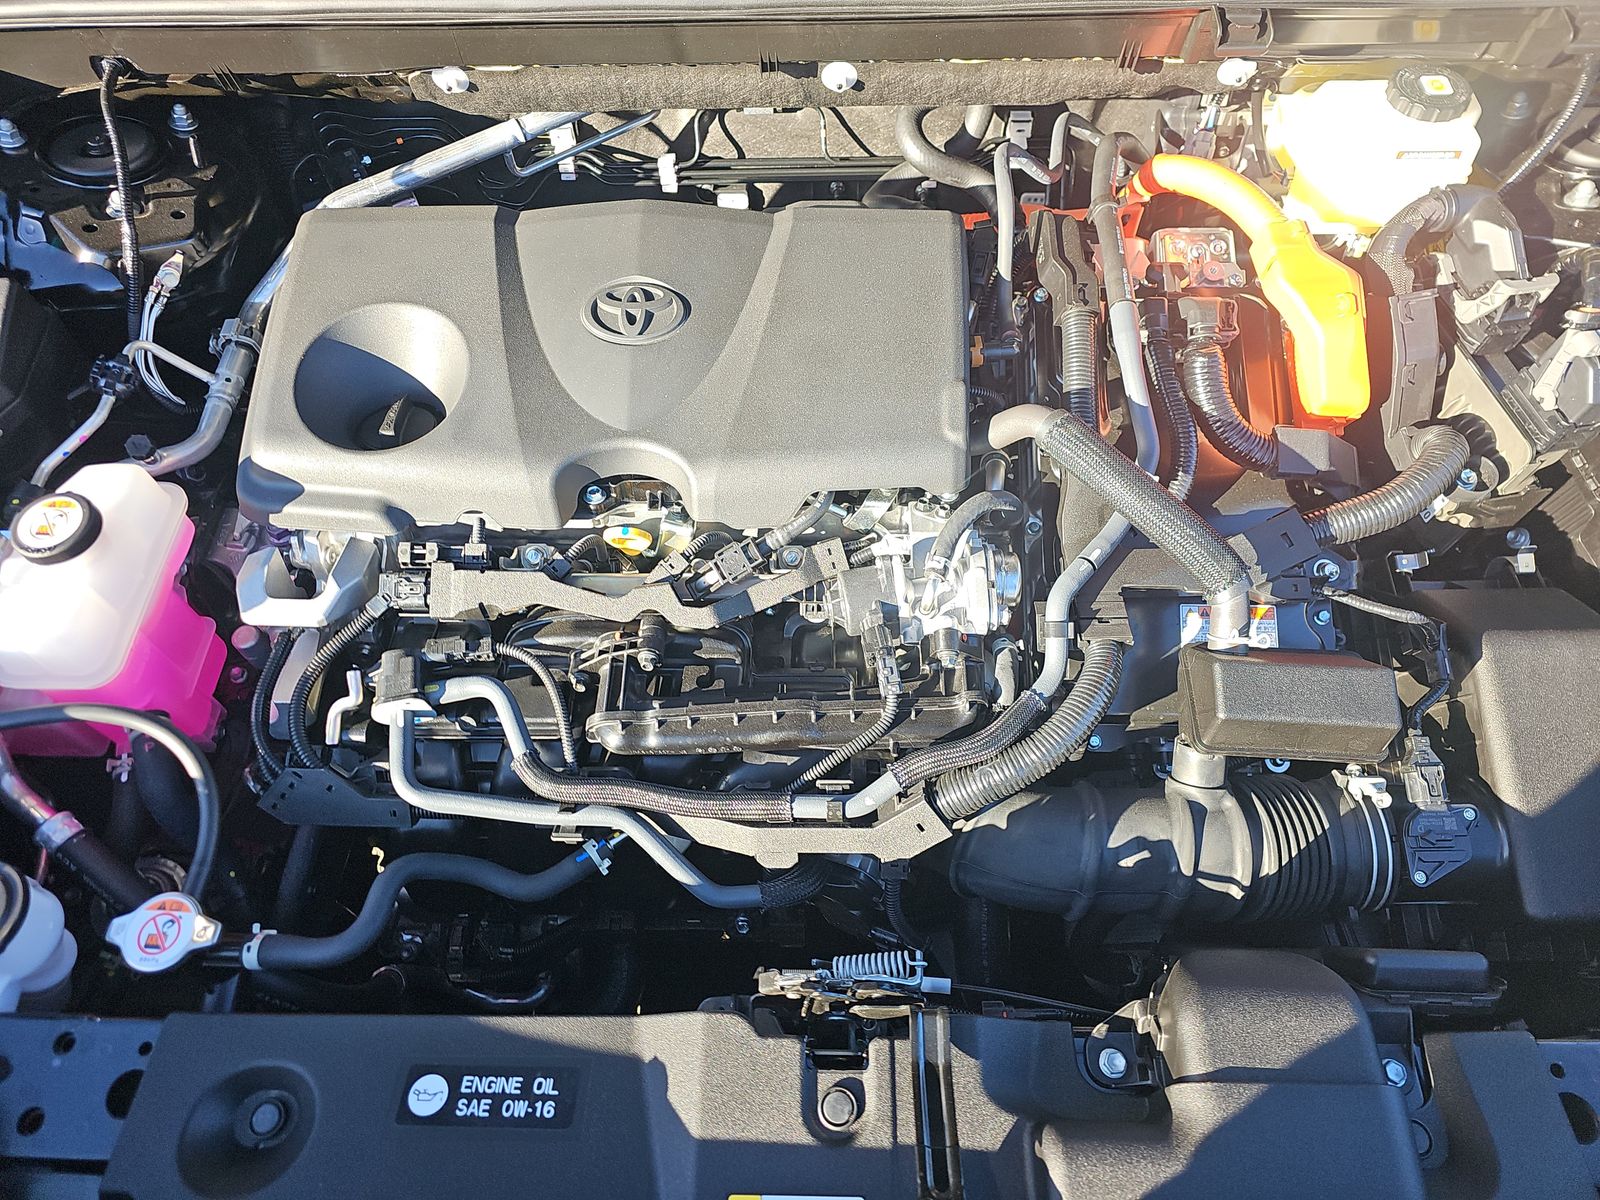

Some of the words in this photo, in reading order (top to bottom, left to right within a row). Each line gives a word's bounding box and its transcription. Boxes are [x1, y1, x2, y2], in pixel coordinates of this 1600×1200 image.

[460, 1075, 523, 1095] ENGINE
[532, 1077, 559, 1096] OIL
[455, 1098, 492, 1118] SAE
[501, 1100, 556, 1119] 0W-16
